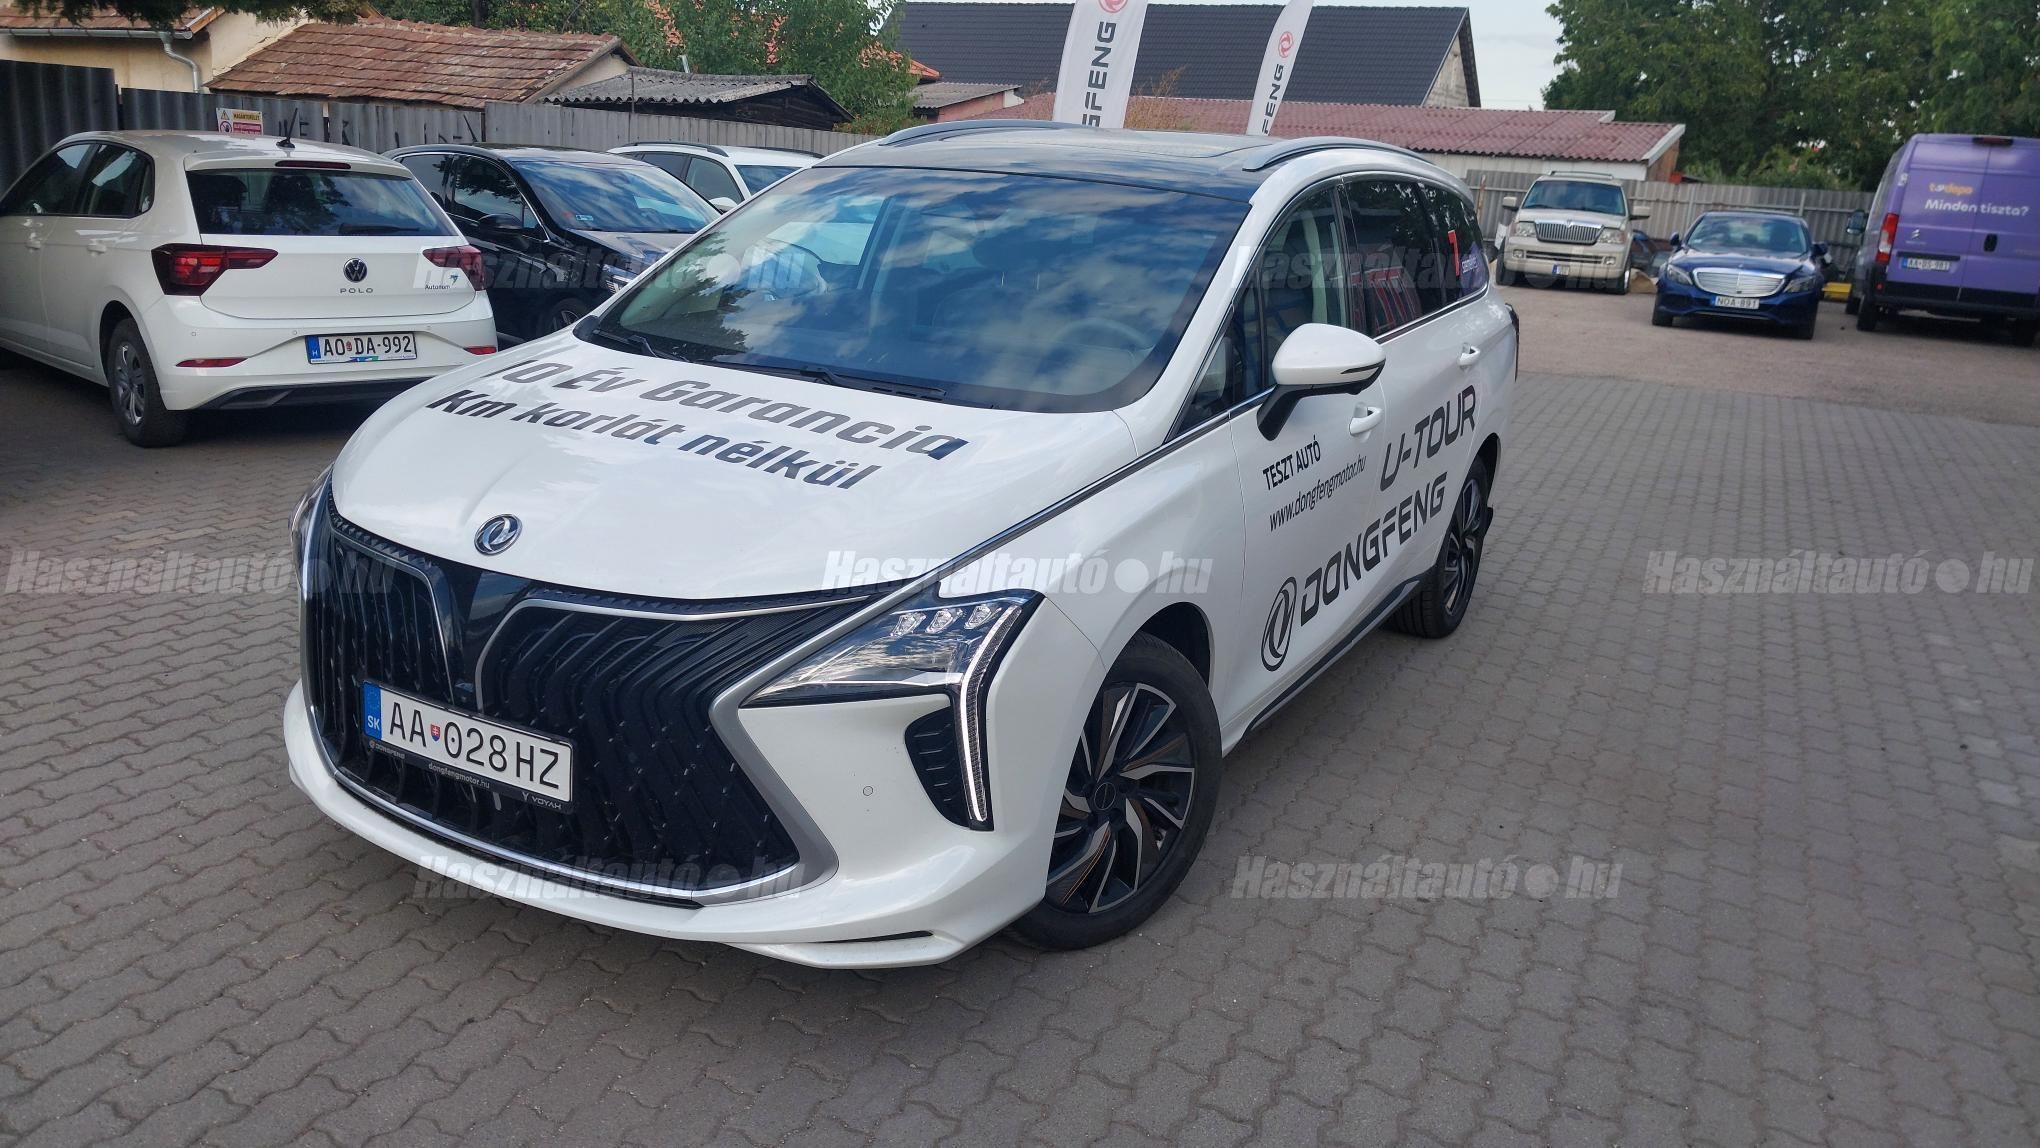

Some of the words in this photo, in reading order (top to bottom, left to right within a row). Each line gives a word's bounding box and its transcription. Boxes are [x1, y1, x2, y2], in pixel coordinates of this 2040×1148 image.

[1924, 199, 1977, 213] Minden
[1980, 203, 2029, 216] tiszta?
[427, 388, 518, 419] Km
[510, 401, 687, 445] korlát
[678, 434, 882, 490] nélkül
[552, 366, 647, 393] Év
[639, 380, 969, 461] Garancia
[1379, 384, 1477, 491] U-TOUR
[1263, 454, 1293, 491] TESZT
[1296, 435, 1321, 473] AUTÓ
[1269, 453, 1367, 532] www.dongfengmotor.hu
[1300, 471, 1448, 627] DONGFENG
[367, 715, 380, 732] SK
[531, 795, 562, 810] VOYAH
